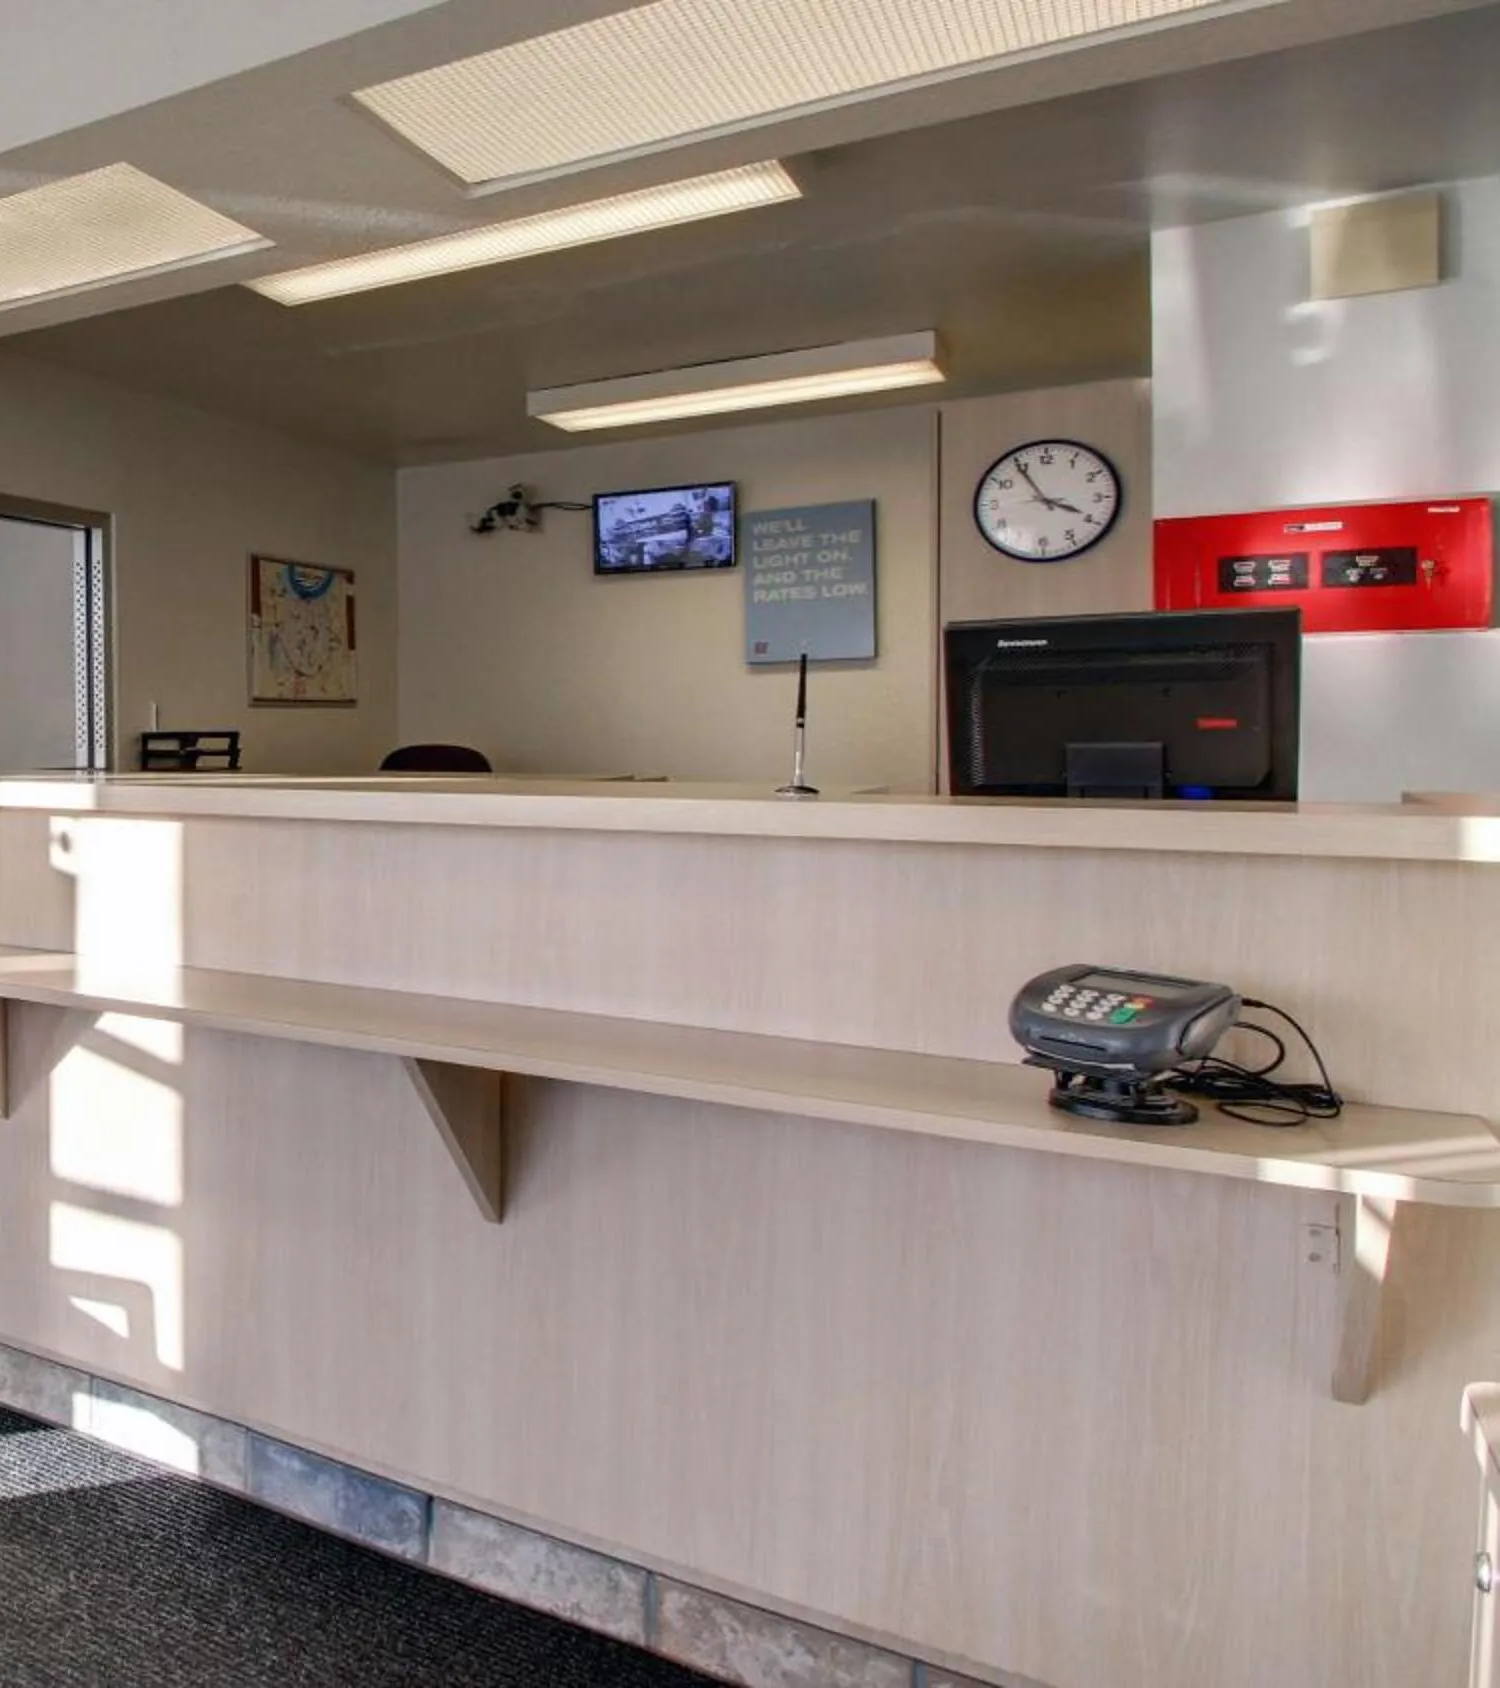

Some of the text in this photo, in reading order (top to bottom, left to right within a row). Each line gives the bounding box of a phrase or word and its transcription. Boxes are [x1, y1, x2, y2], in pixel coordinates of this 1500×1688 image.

[998, 479, 1013, 490] 10
[753, 519, 808, 535] WE'LL
[753, 529, 863, 550] LEAVE THE
[753, 552, 811, 569] LIGHT
[754, 568, 844, 586] AND THE
[753, 585, 817, 604] RATES
